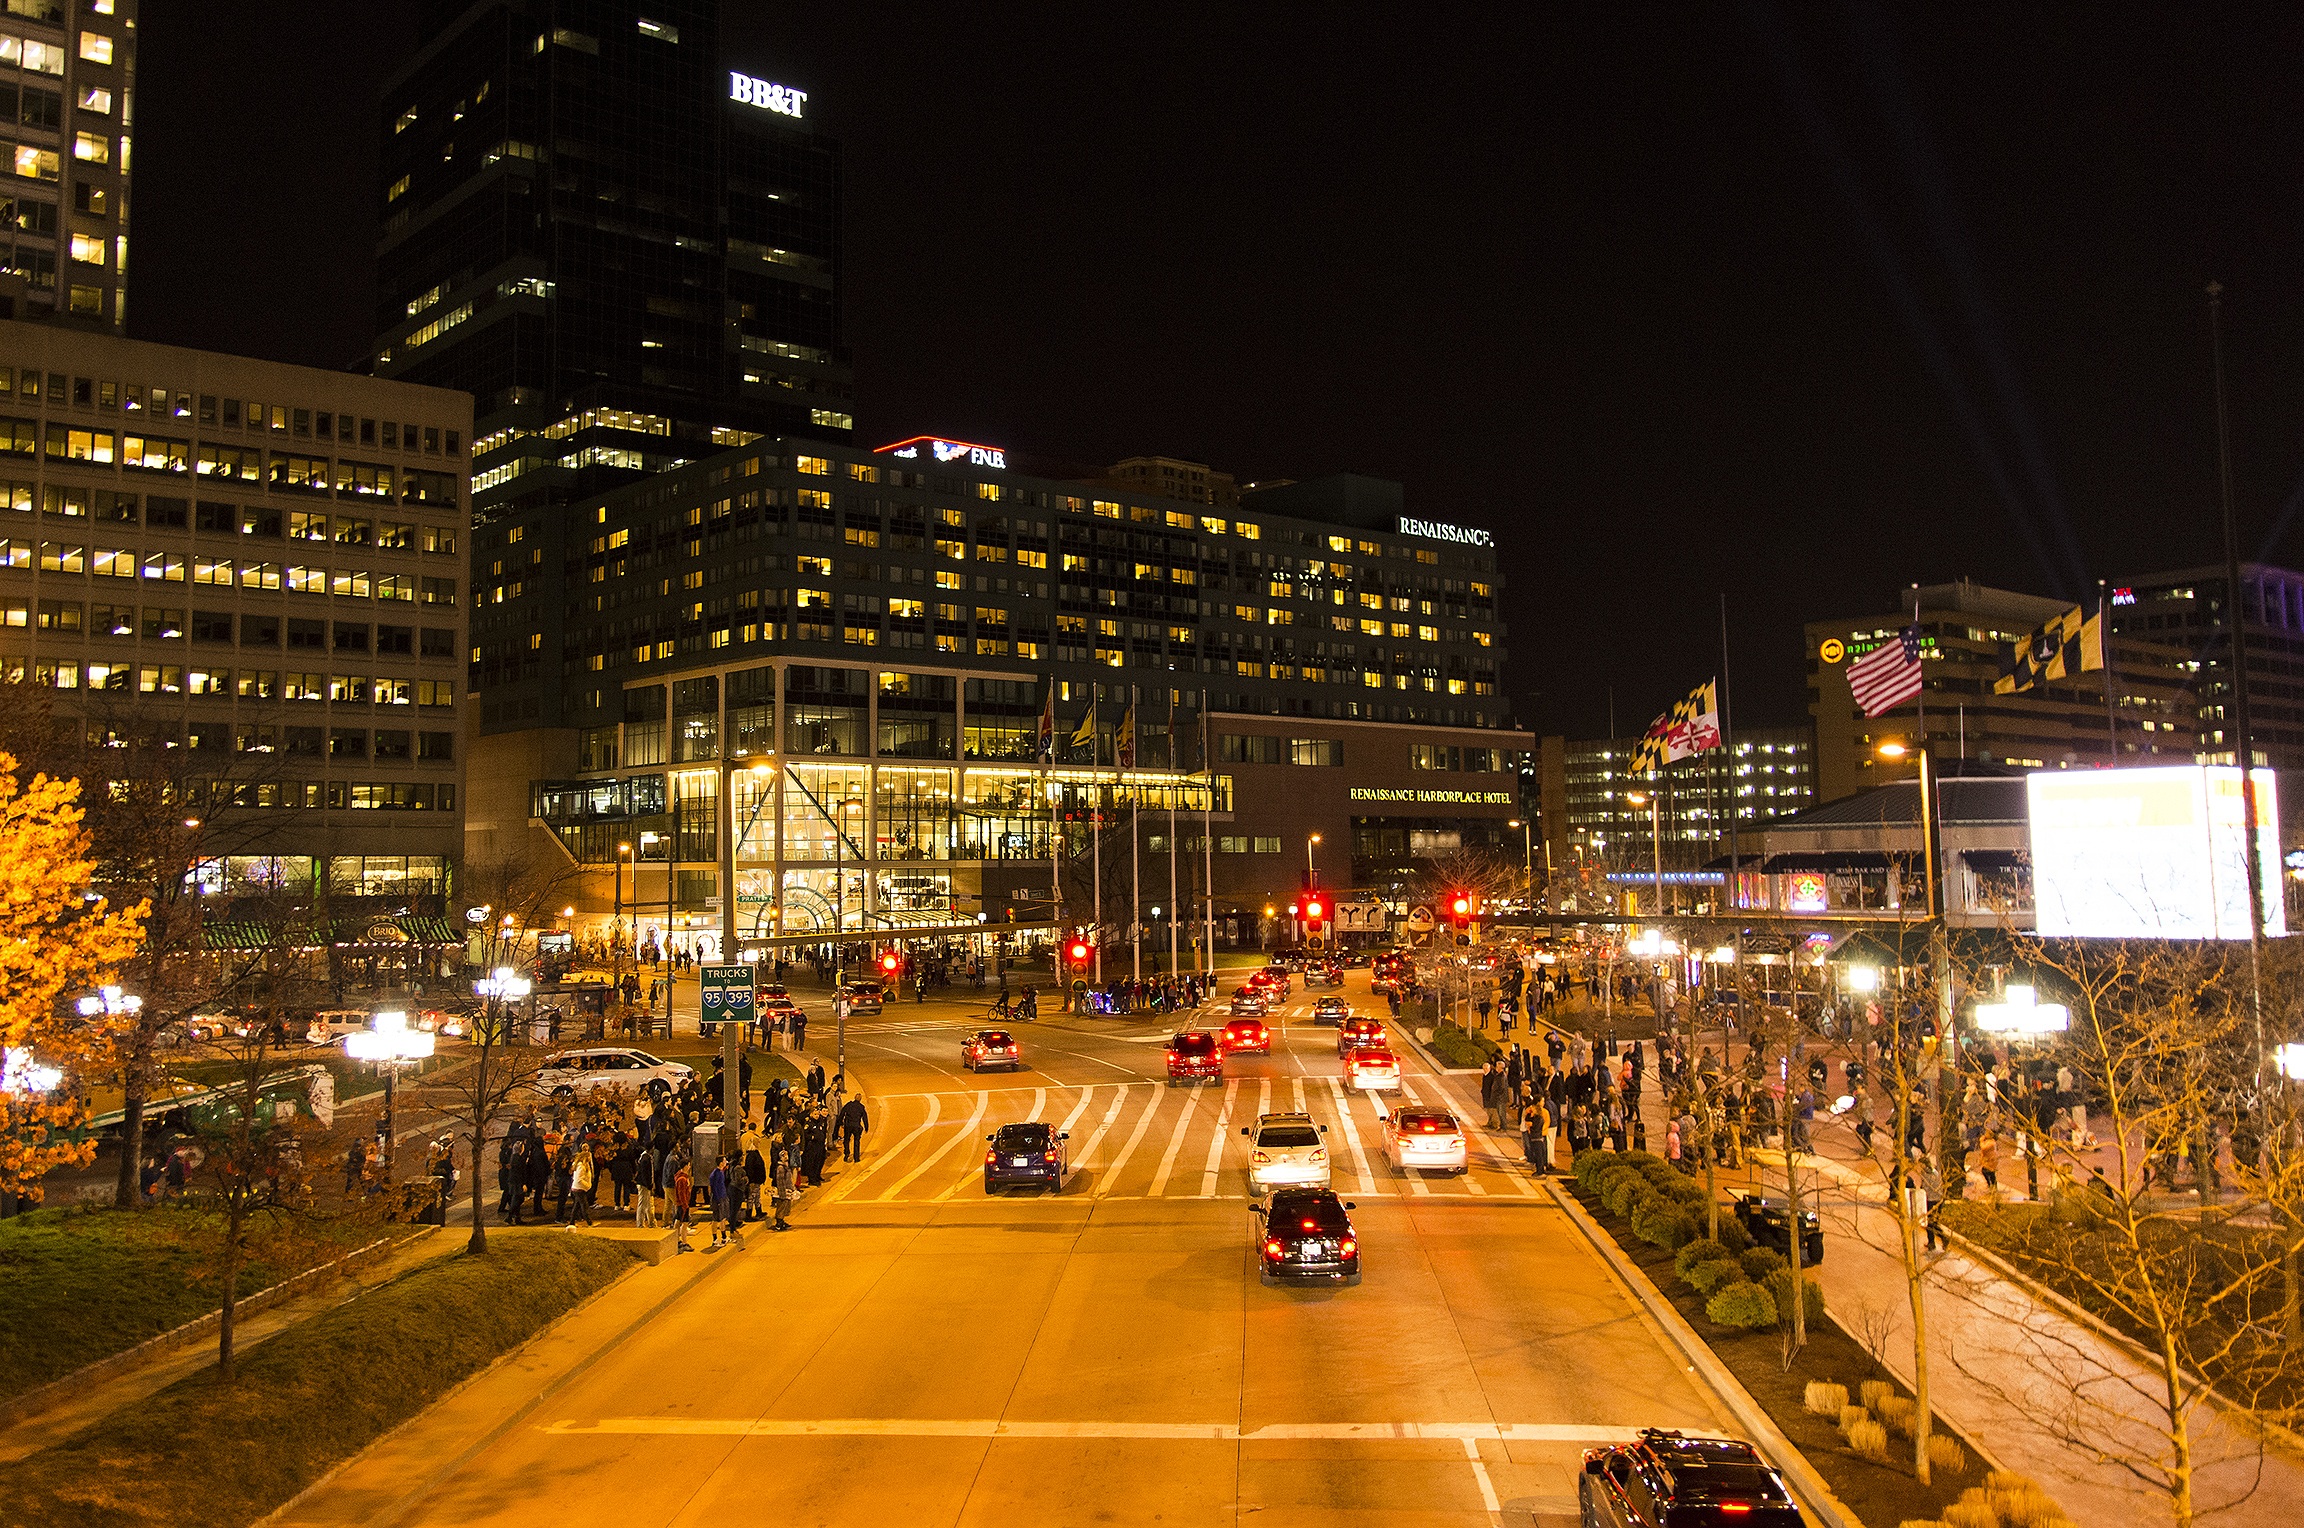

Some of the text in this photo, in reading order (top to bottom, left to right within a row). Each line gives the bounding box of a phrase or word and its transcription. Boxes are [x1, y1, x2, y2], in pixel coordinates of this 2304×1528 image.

[729, 70, 807, 119] BB&T
[1350, 787, 1511, 804] RENAISSANCE HARBORPLACE HOTEL
[373, 927, 396, 936] BRIO
[707, 969, 748, 978] TRUCKS
[705, 992, 751, 1003] 95 395
